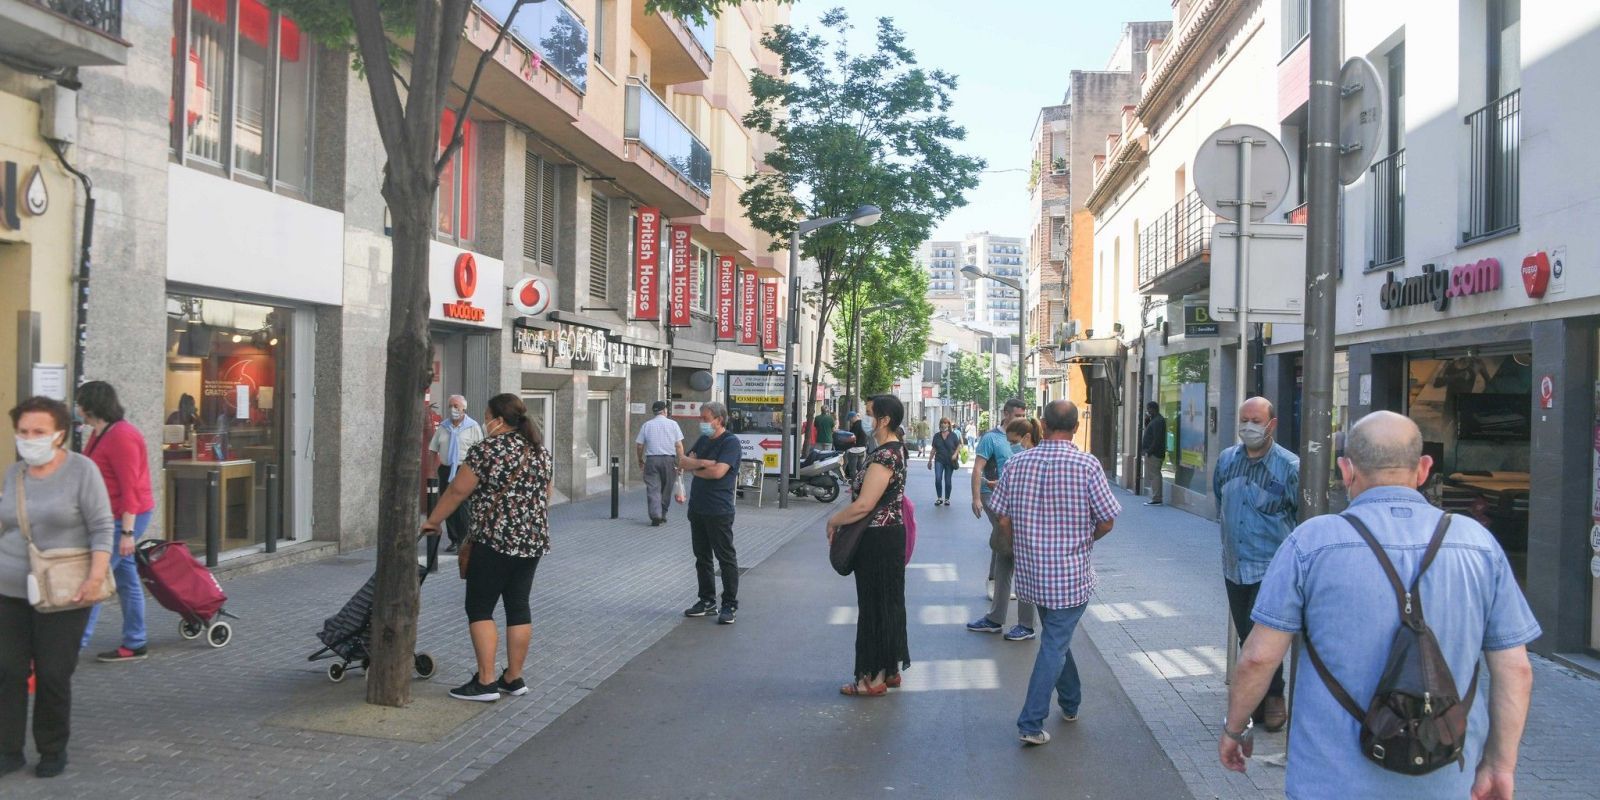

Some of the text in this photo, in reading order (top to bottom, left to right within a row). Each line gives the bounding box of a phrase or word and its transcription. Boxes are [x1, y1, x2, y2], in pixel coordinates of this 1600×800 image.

[639, 212, 655, 311] British House
[674, 230, 687, 318] British House
[1379, 257, 1503, 312] dormity.com
[443, 300, 486, 321] vodafone
[721, 260, 732, 332] British House
[745, 274, 755, 339] British House
[765, 286, 775, 344] British House
